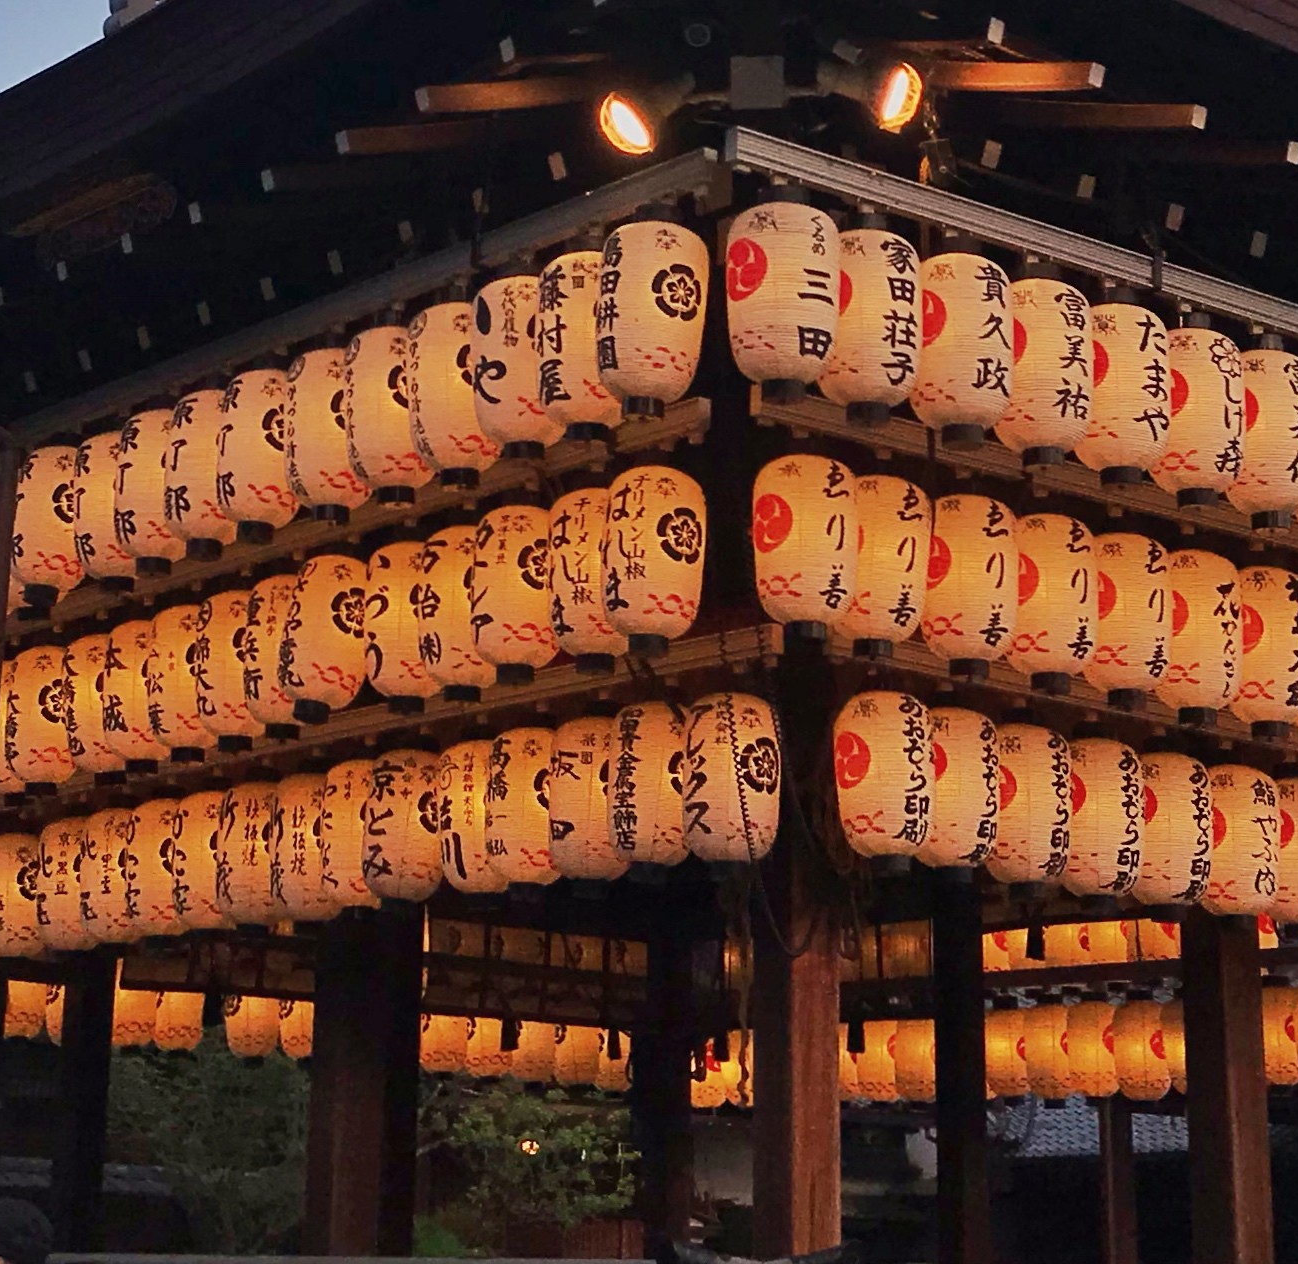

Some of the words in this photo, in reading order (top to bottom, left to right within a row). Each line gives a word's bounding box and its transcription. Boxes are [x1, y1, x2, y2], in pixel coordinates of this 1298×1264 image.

[797, 268, 835, 361] 三田
[880, 238, 920, 386] 家田荘子
[1133, 313, 1171, 442] たまや
